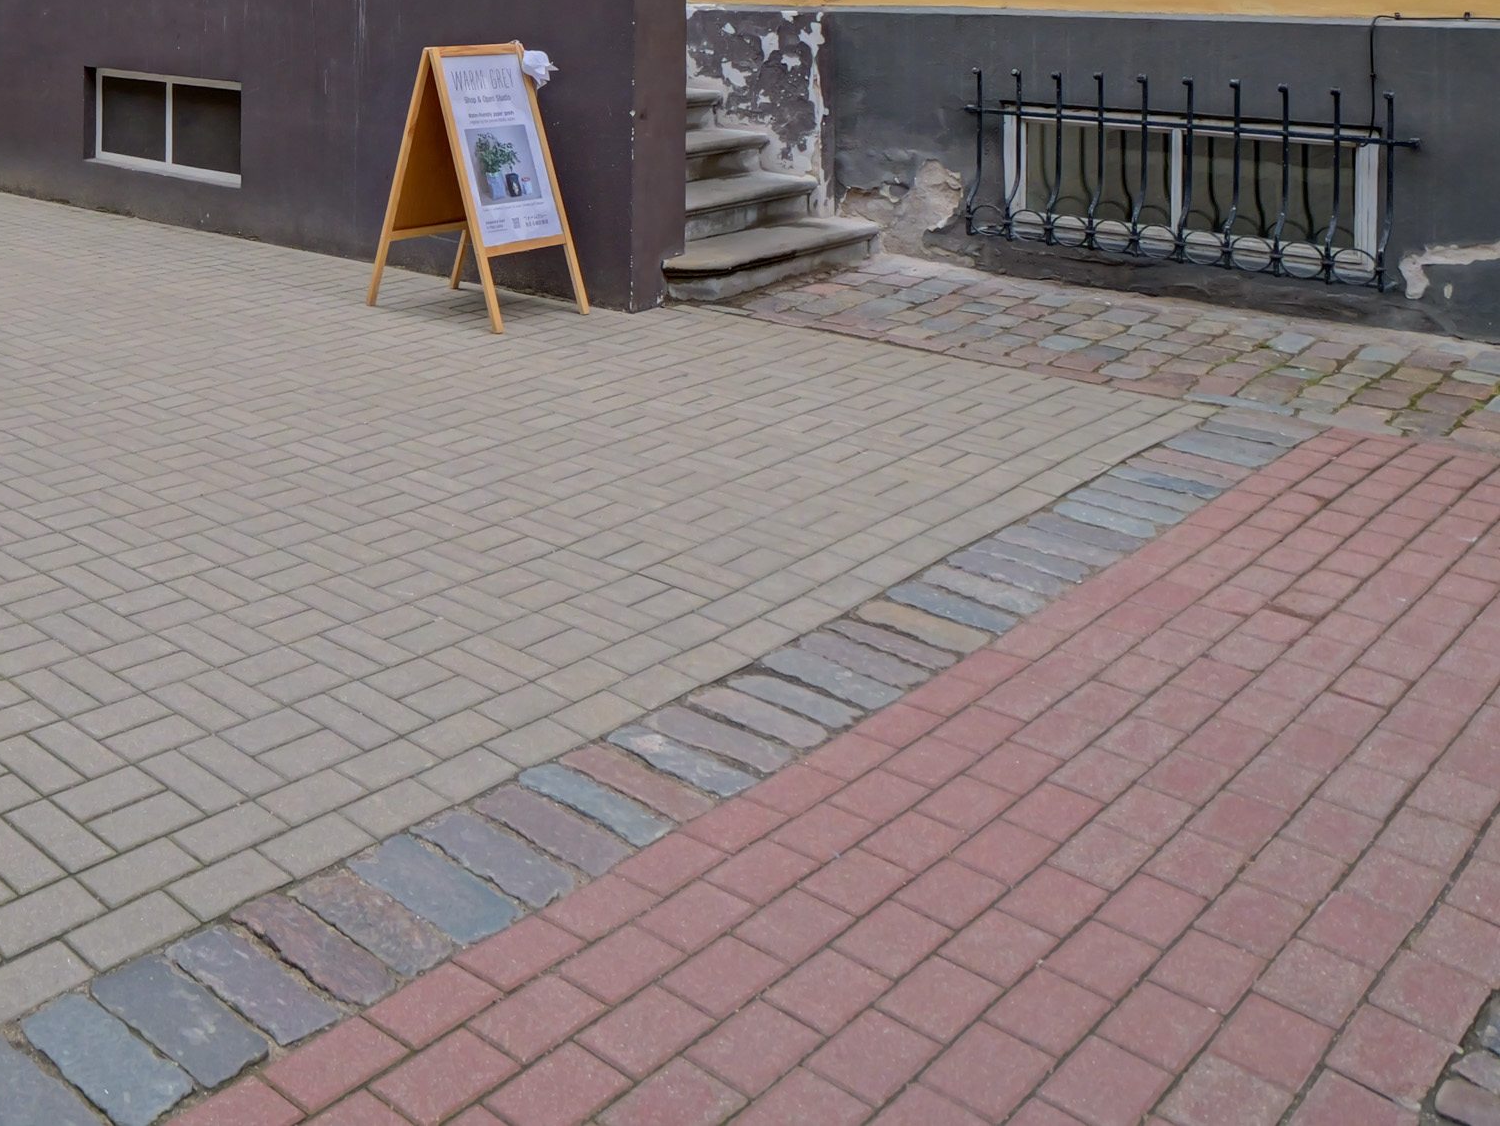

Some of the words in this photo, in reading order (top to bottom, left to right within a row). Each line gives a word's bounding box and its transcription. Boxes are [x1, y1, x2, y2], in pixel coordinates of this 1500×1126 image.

[451, 69, 486, 92] WARM
[489, 67, 514, 90] GREY
[464, 96, 477, 104] Shop
[482, 95, 495, 104] Open
[495, 94, 511, 102] Studio
